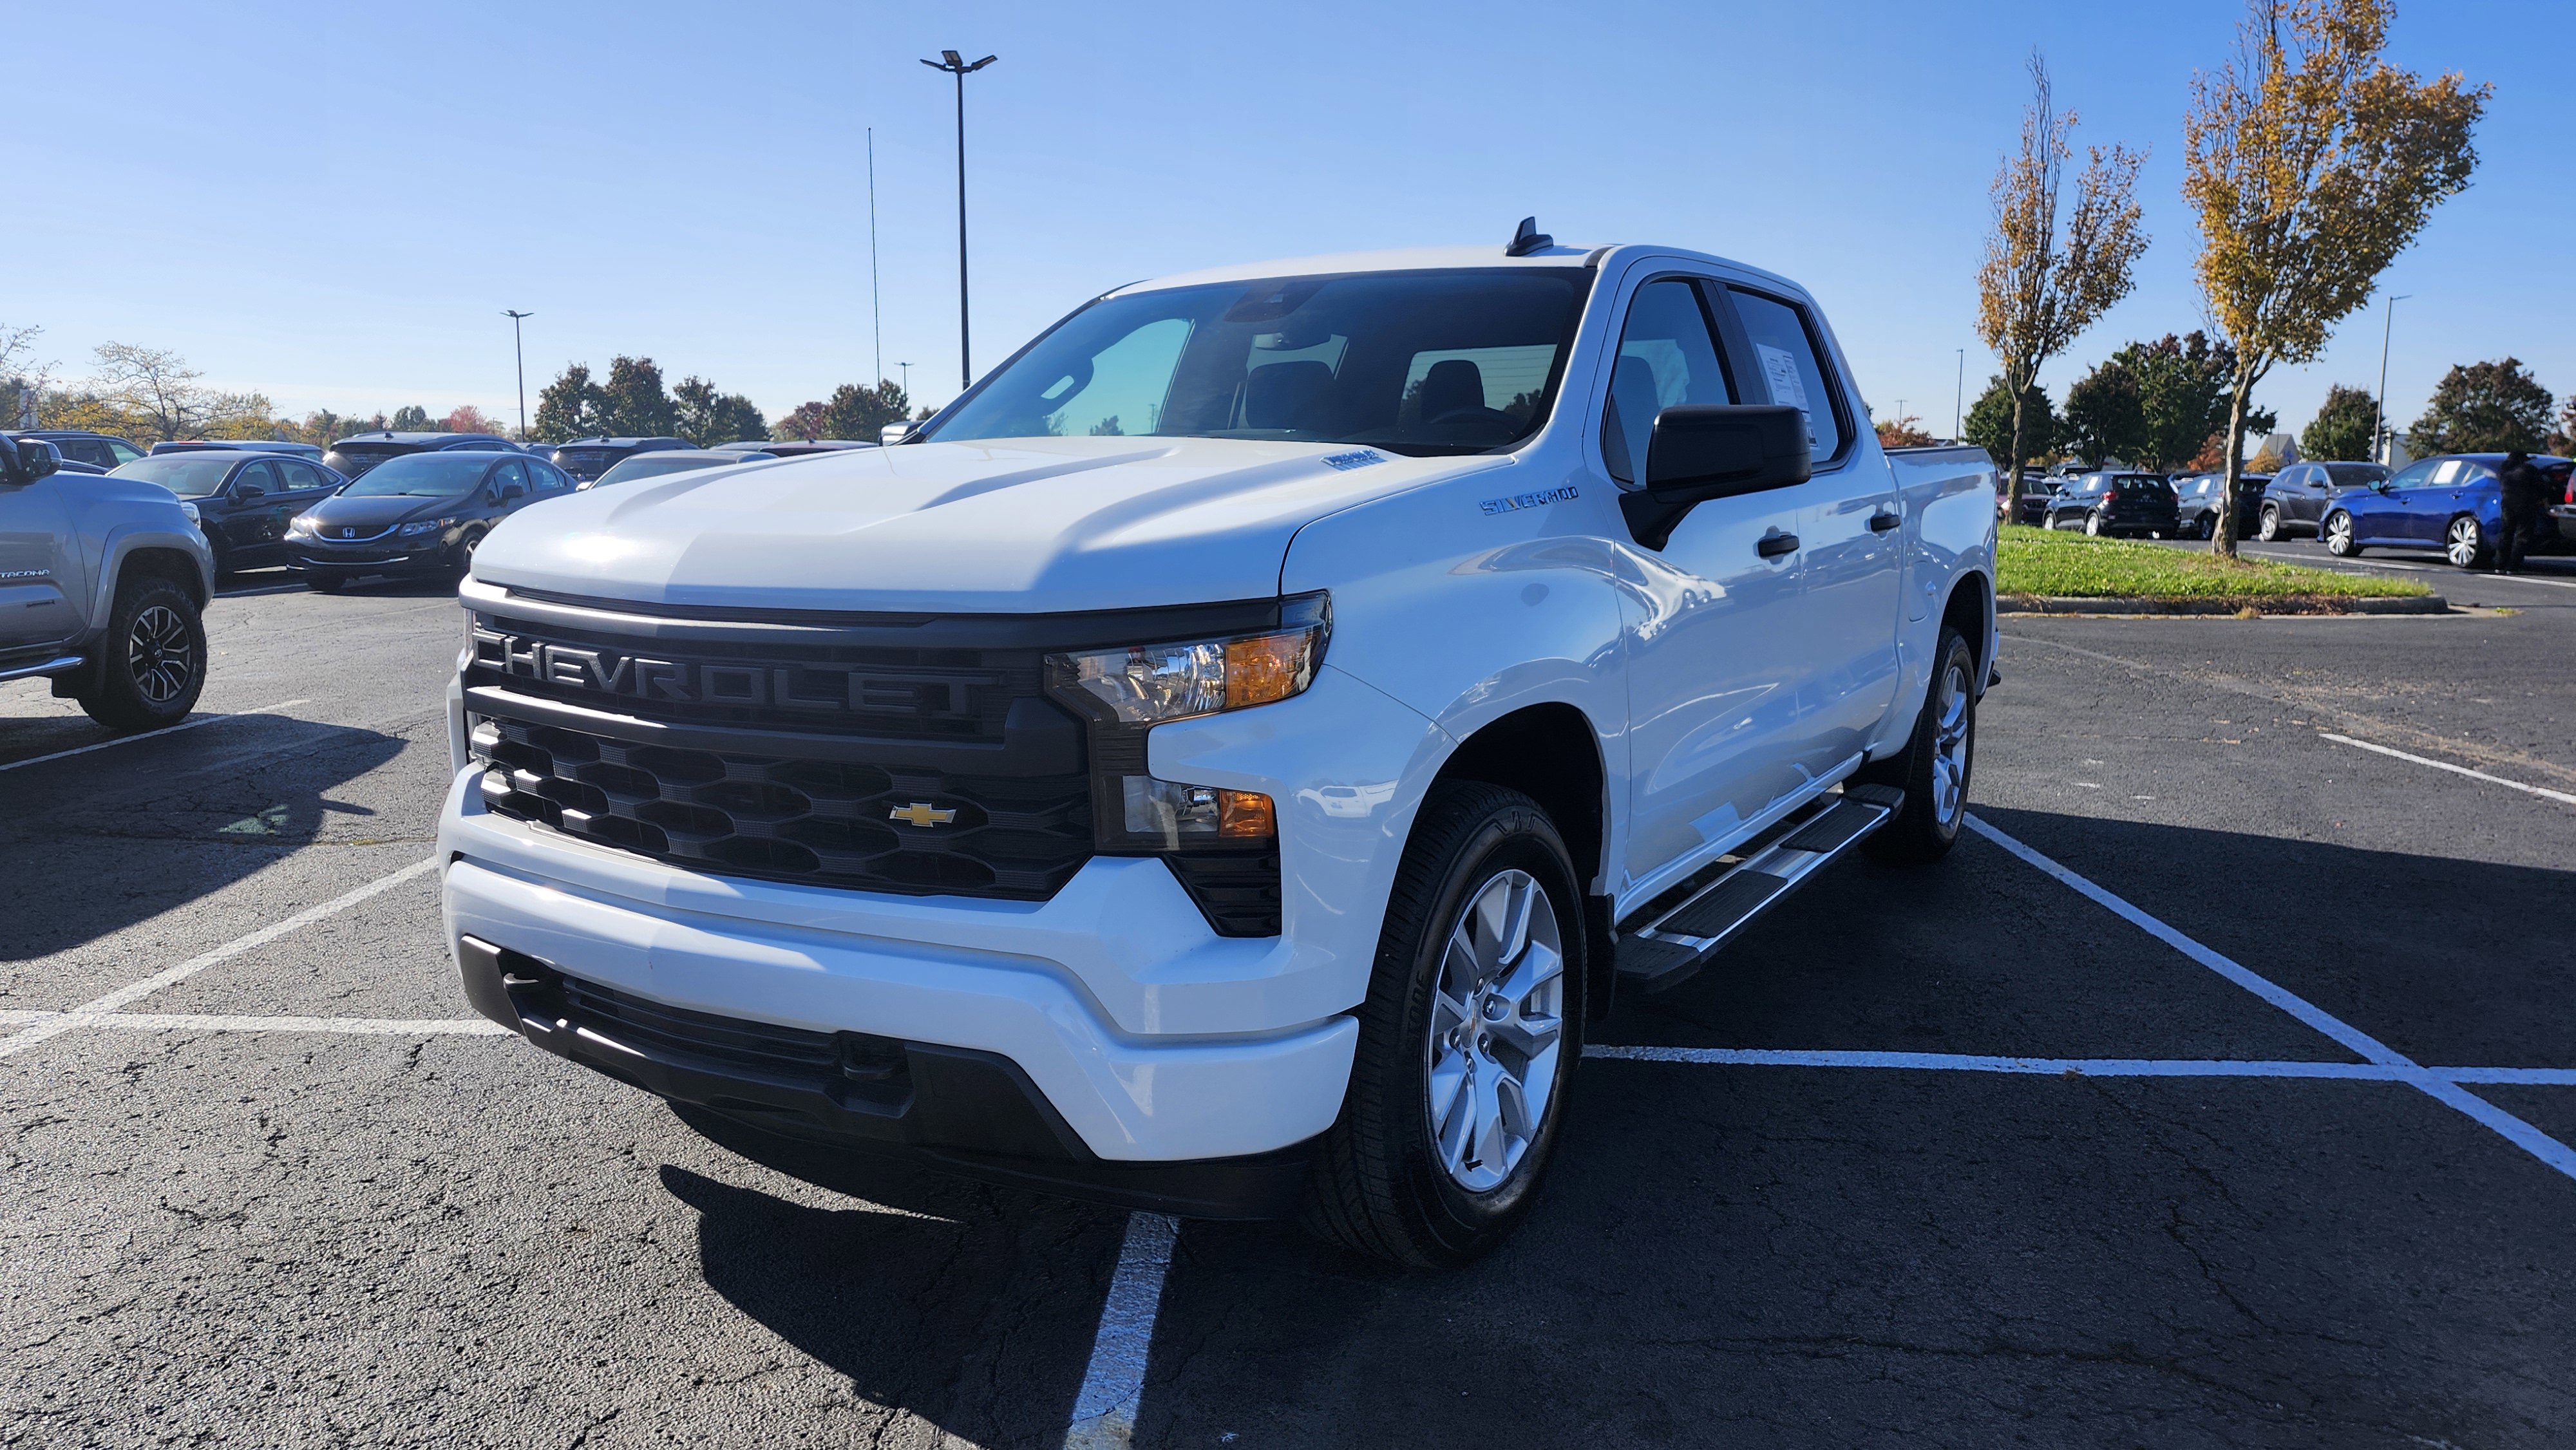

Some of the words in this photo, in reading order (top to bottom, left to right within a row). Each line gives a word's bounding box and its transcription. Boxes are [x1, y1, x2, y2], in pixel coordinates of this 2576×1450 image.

[1479, 486, 1579, 516] SILVERADO
[0, 569, 50, 578] TACOMA
[472, 630, 1002, 715] CHEVROLET
